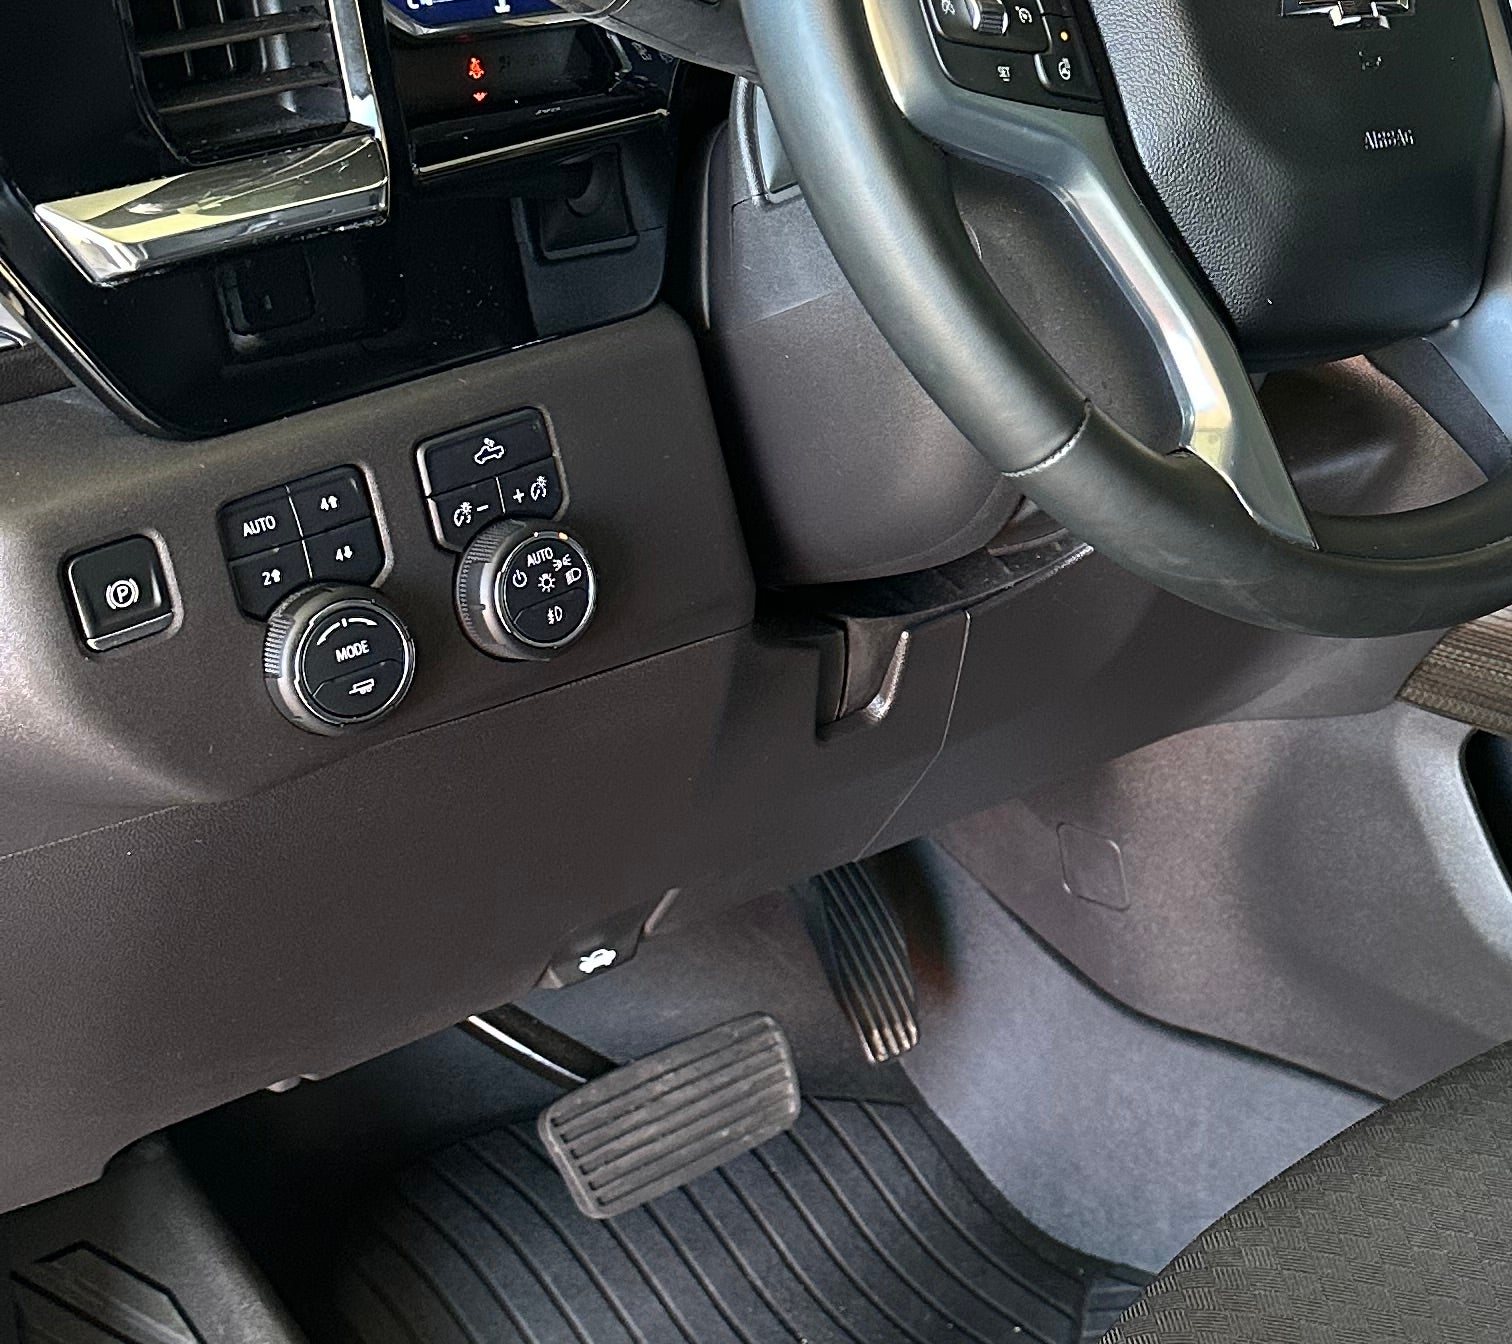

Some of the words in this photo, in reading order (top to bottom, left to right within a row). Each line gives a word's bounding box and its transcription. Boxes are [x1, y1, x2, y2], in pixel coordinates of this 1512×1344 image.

[243, 514, 277, 537] AUTO
[526, 546, 554, 568] AUTO
[335, 639, 370, 663] MODE
